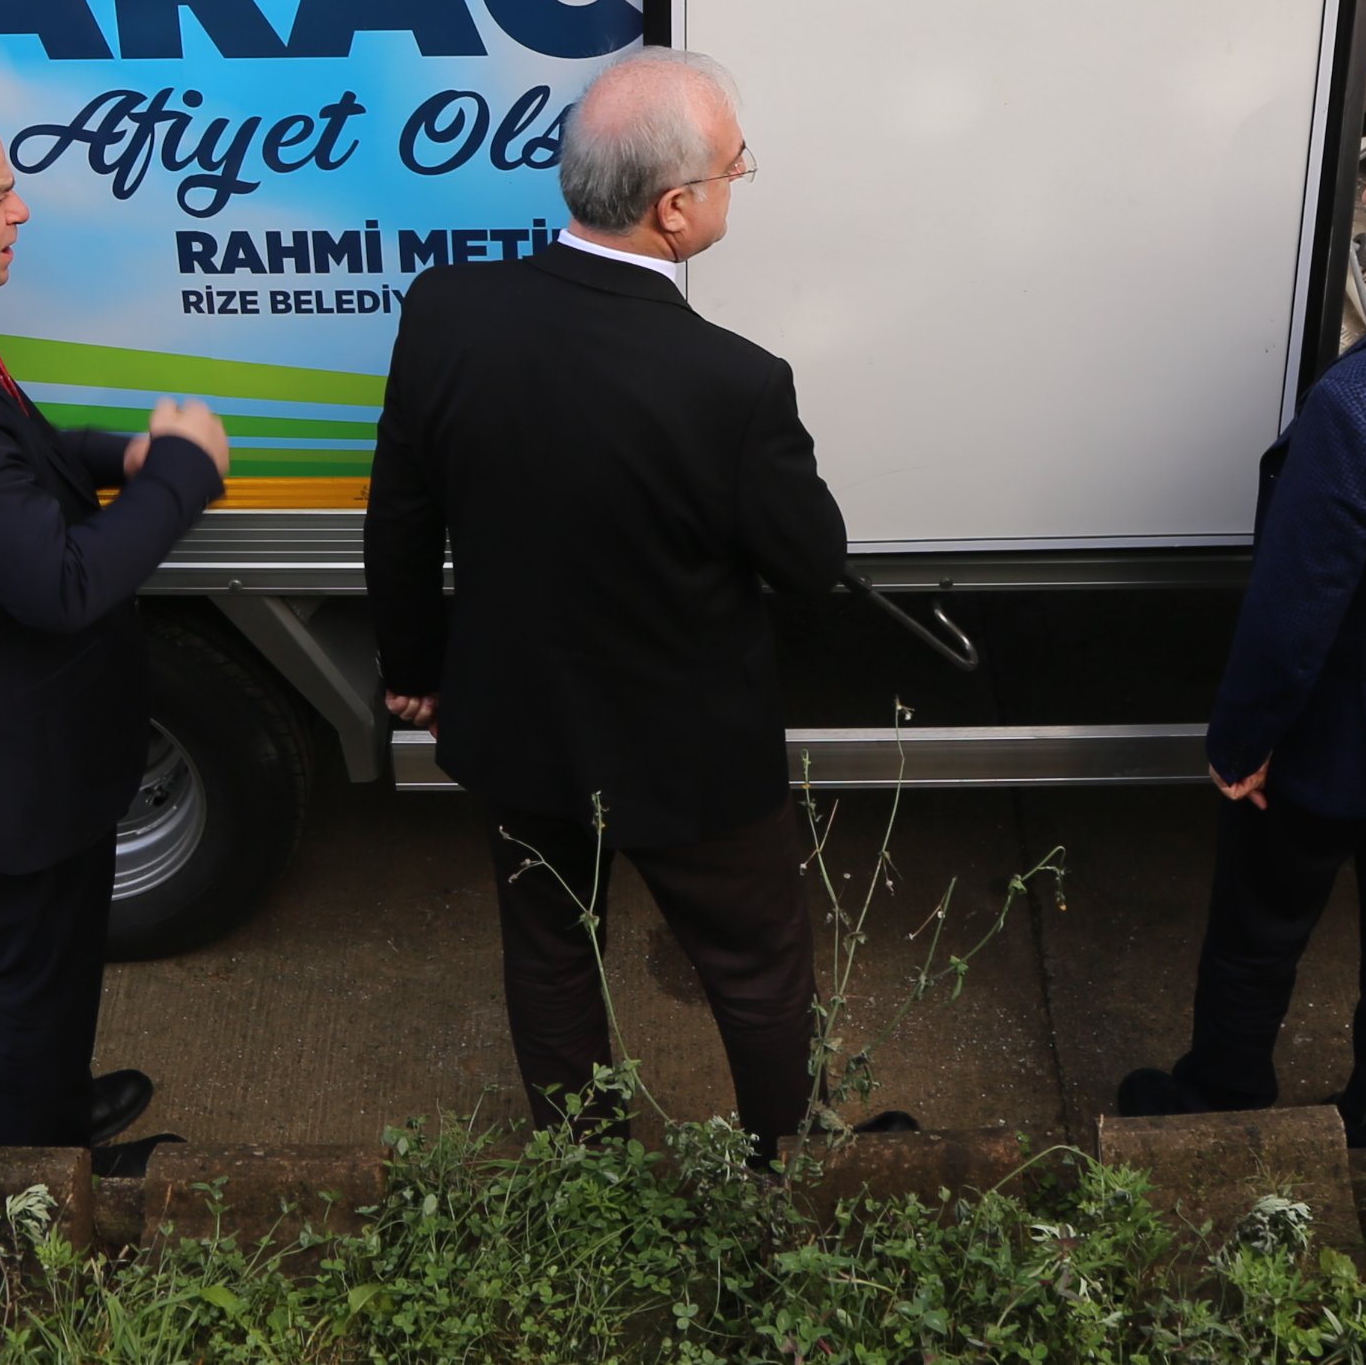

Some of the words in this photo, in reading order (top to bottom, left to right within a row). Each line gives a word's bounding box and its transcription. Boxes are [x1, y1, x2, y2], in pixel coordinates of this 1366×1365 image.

[9, 88, 367, 218] Afiyet
[176, 219, 383, 274] RAHMİ
[398, 218, 562, 274] METİ
[182, 284, 260, 314] RİZE
